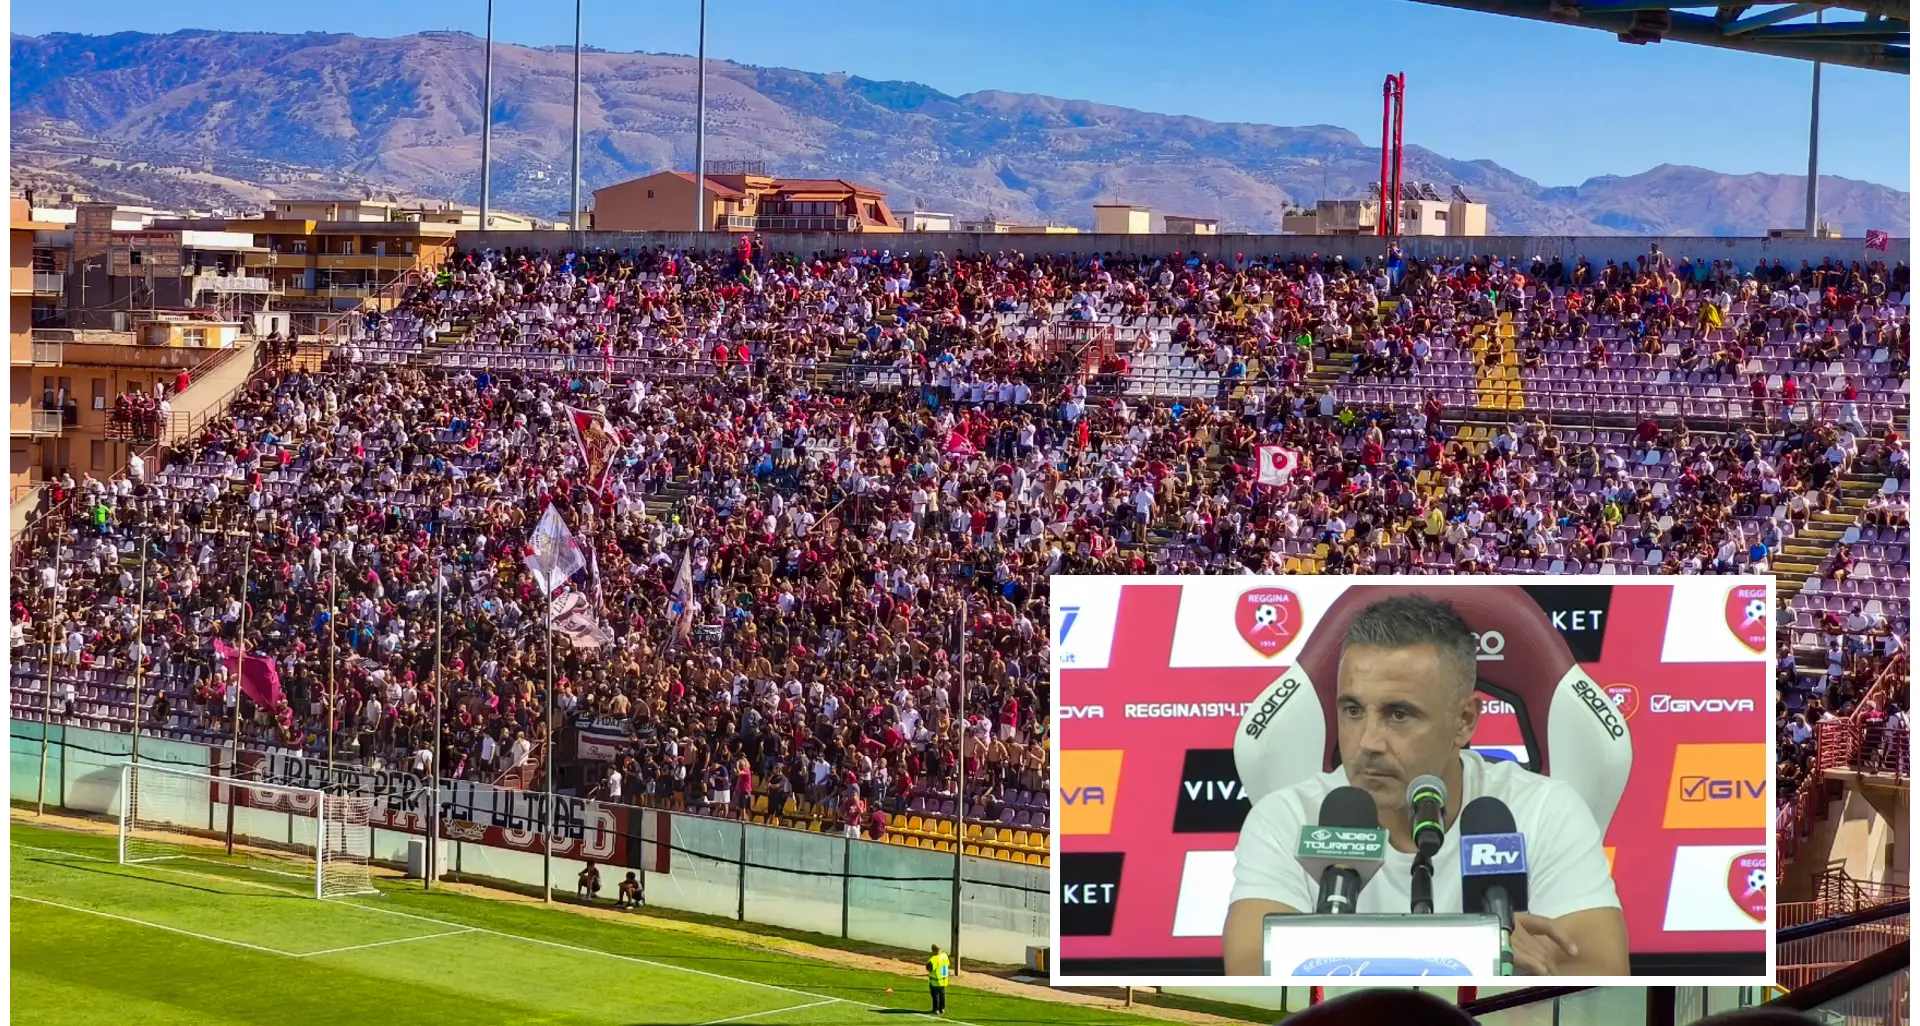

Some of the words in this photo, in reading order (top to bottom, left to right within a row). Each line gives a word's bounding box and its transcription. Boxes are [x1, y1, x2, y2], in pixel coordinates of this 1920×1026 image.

[1247, 594, 1290, 603] REGGINA
[1245, 678, 1300, 740] sparco
[1571, 680, 1624, 741] sparco
[1670, 699, 1754, 712] GIVOVA
[1709, 780, 1766, 799] GIV
[1063, 883, 1115, 904] KET
